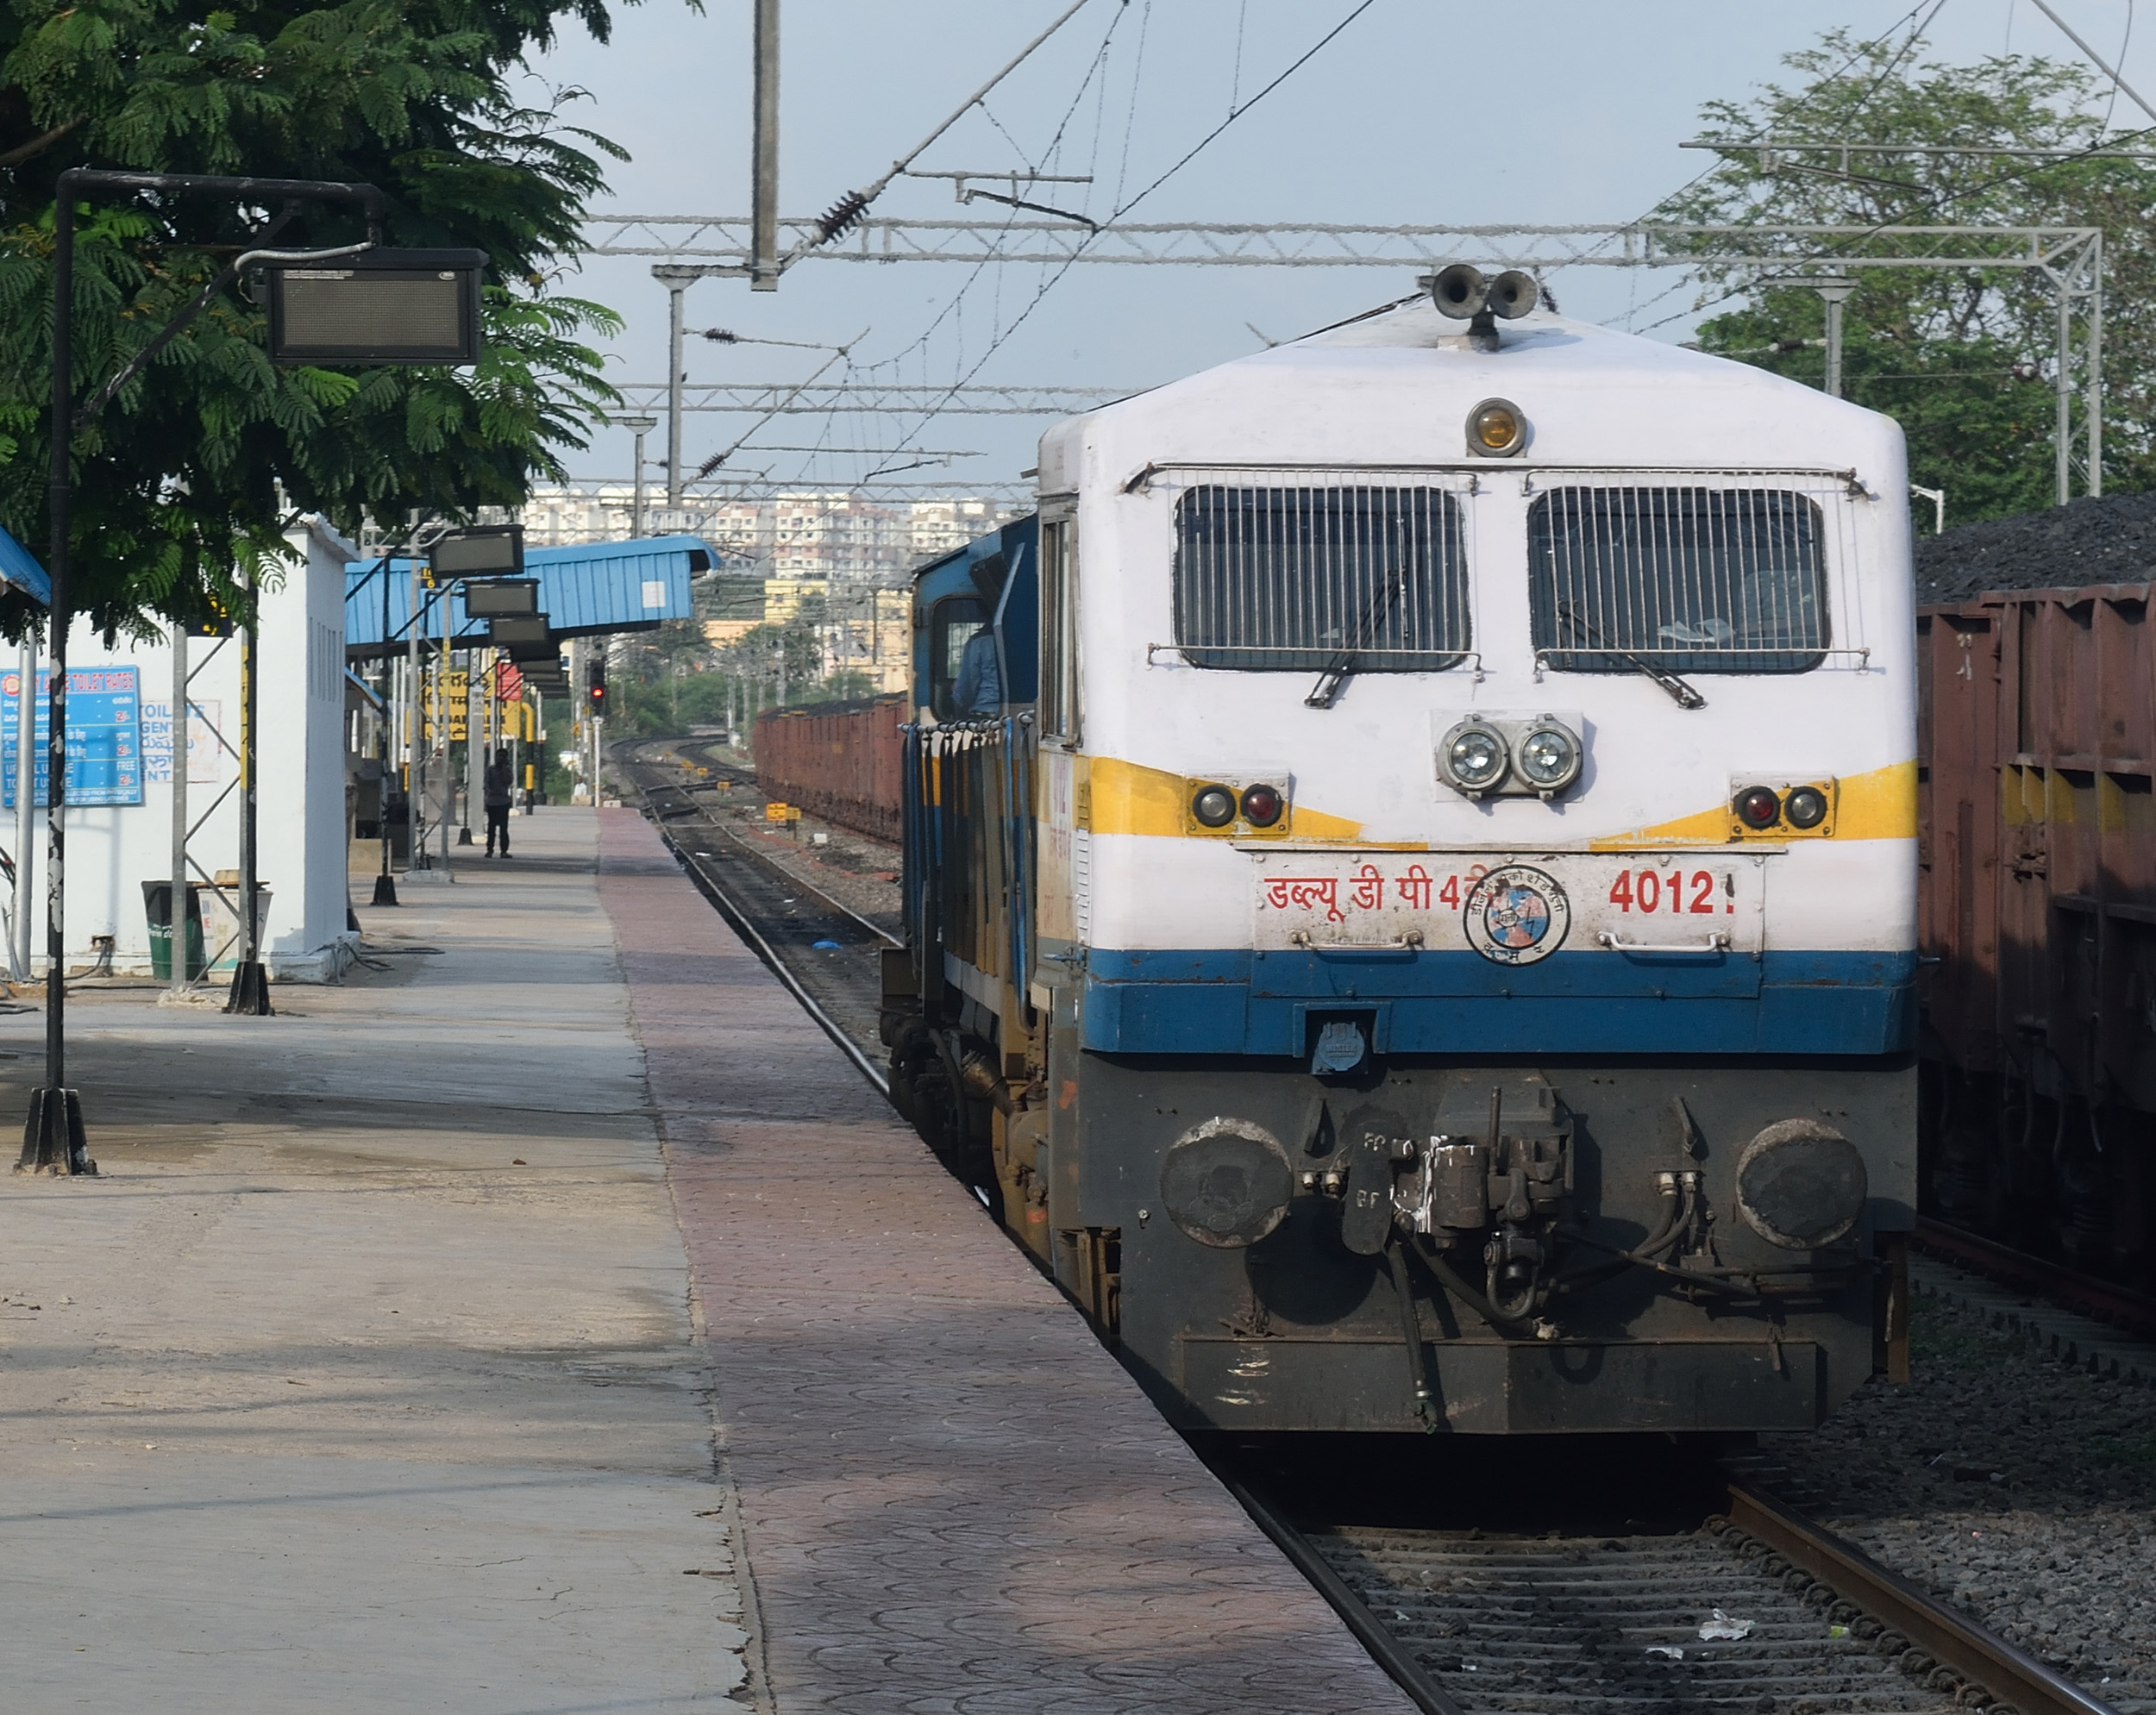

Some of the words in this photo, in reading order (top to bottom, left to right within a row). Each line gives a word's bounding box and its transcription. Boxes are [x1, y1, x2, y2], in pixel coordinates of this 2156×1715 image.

[72, 673, 103, 691] TOILET
[106, 672, 133, 690] RATES
[116, 760, 136, 771] FREE
[1263, 878, 1344, 923] डब्ल्यू
[1350, 864, 1384, 910] डी
